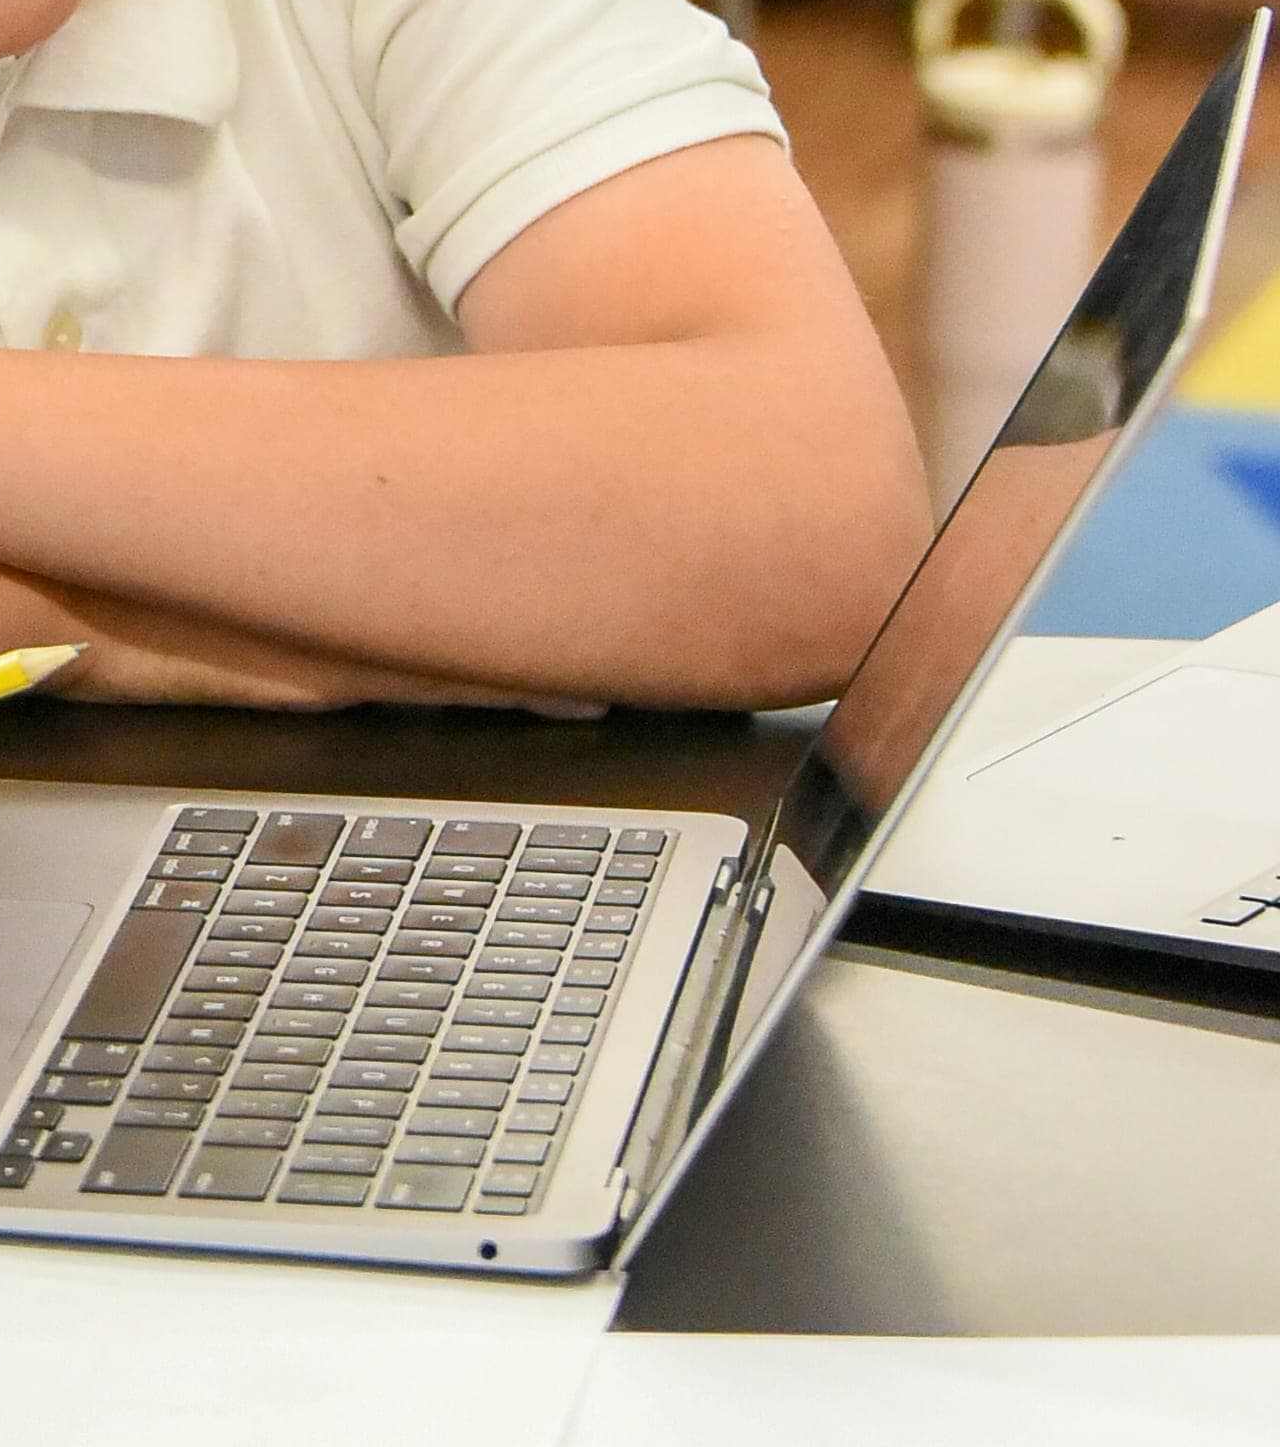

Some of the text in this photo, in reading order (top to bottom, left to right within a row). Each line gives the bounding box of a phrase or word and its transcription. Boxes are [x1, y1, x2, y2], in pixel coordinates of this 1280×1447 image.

[350, 891, 372, 899] S
[386, 1018, 408, 1026] U
[362, 1071, 386, 1080] O
[351, 1099, 375, 1107] P
